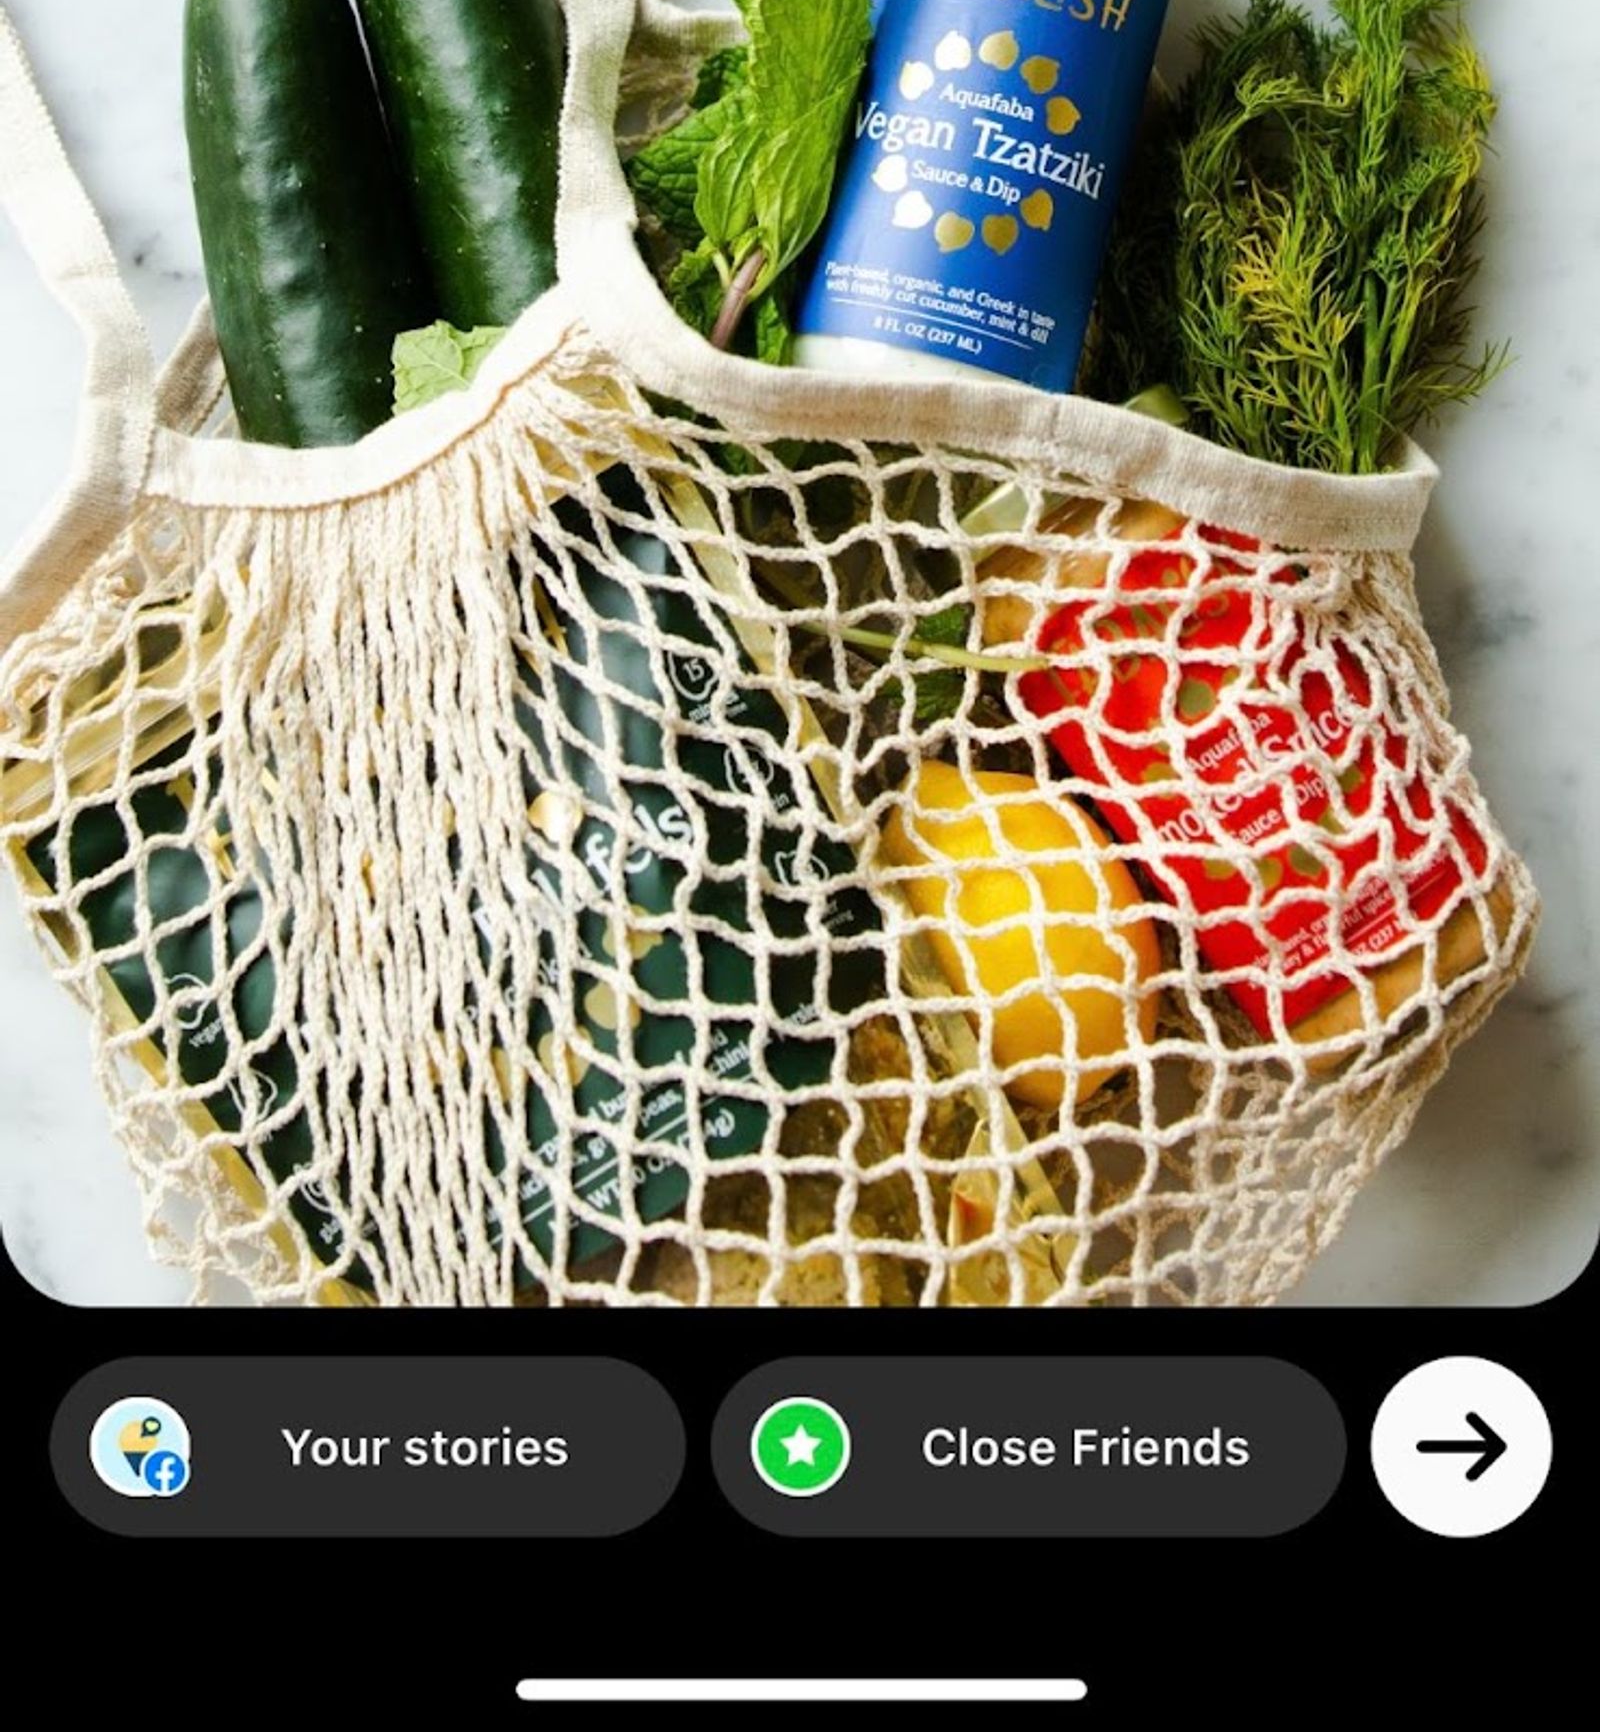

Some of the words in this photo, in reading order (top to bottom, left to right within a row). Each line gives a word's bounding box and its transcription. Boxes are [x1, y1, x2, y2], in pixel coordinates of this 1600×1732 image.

[939, 83, 1034, 122] Aquafaba
[855, 101, 956, 152] Vegan
[972, 117, 1105, 200] Tzatziki
[912, 160, 967, 188] Sauce
[969, 177, 984, 191] &
[985, 176, 1021, 206] Dip
[893, 273, 944, 296] organic,
[947, 284, 975, 303] and
[977, 292, 1016, 316] Greek
[1017, 304, 1030, 319] in
[896, 288, 917, 305] cut
[919, 295, 986, 324] cucumber,
[988, 311, 1017, 332] mint
[1017, 322, 1030, 337] &
[1031, 327, 1050, 344] dill
[884, 319, 902, 334] FL
[904, 321, 927, 340] OZ
[927, 326, 956, 346] (237
[956, 334, 983, 355] ML)
[1230, 808, 1281, 845] auce
[281, 1428, 391, 1467] Your
[404, 1426, 569, 1466] stories
[922, 1426, 1056, 1467] Close
[1073, 1426, 1250, 1466] Friends
